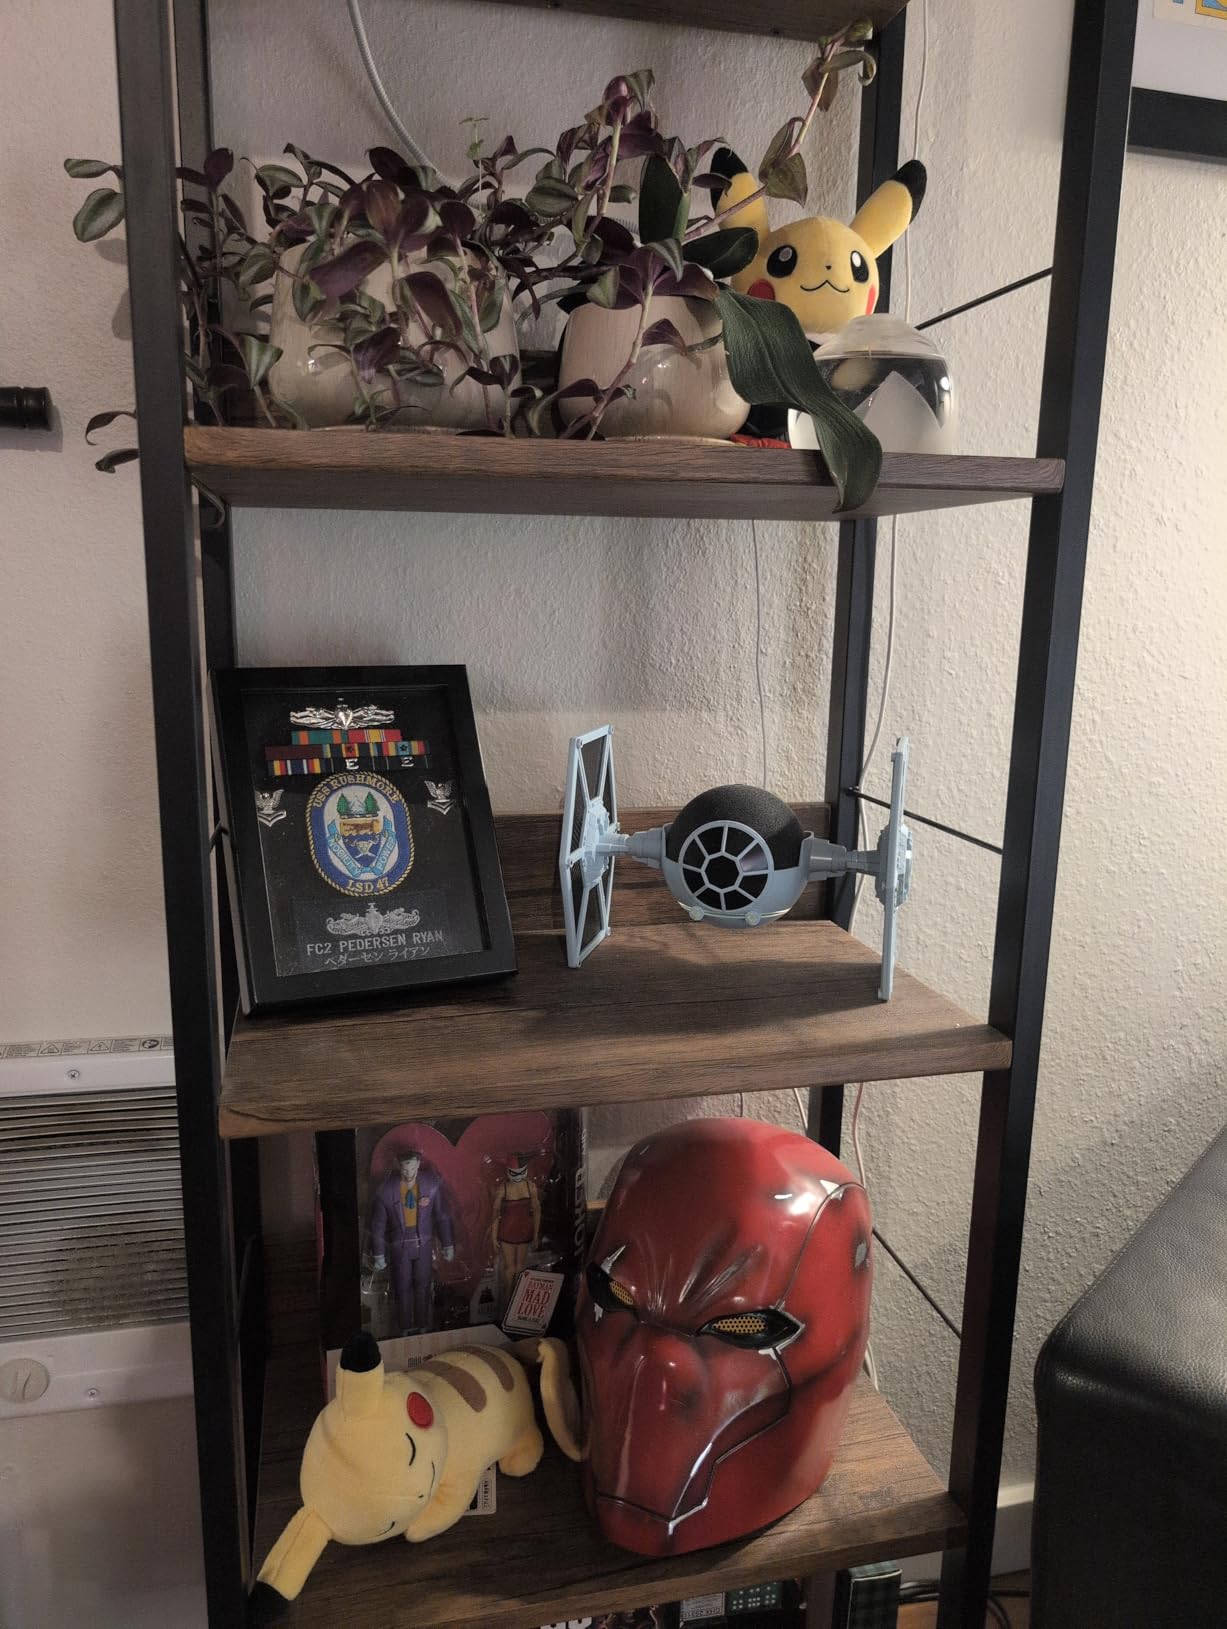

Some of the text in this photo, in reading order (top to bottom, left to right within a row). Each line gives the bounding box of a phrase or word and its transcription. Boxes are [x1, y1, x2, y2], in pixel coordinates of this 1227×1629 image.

[313, 773, 400, 808] USS RUSHMORE
[346, 877, 389, 893] LSD 47
[306, 930, 444, 956] FC2 PEDERSEN RYAN
[522, 1289, 551, 1305] MAD
[517, 1302, 545, 1319] LOVE
